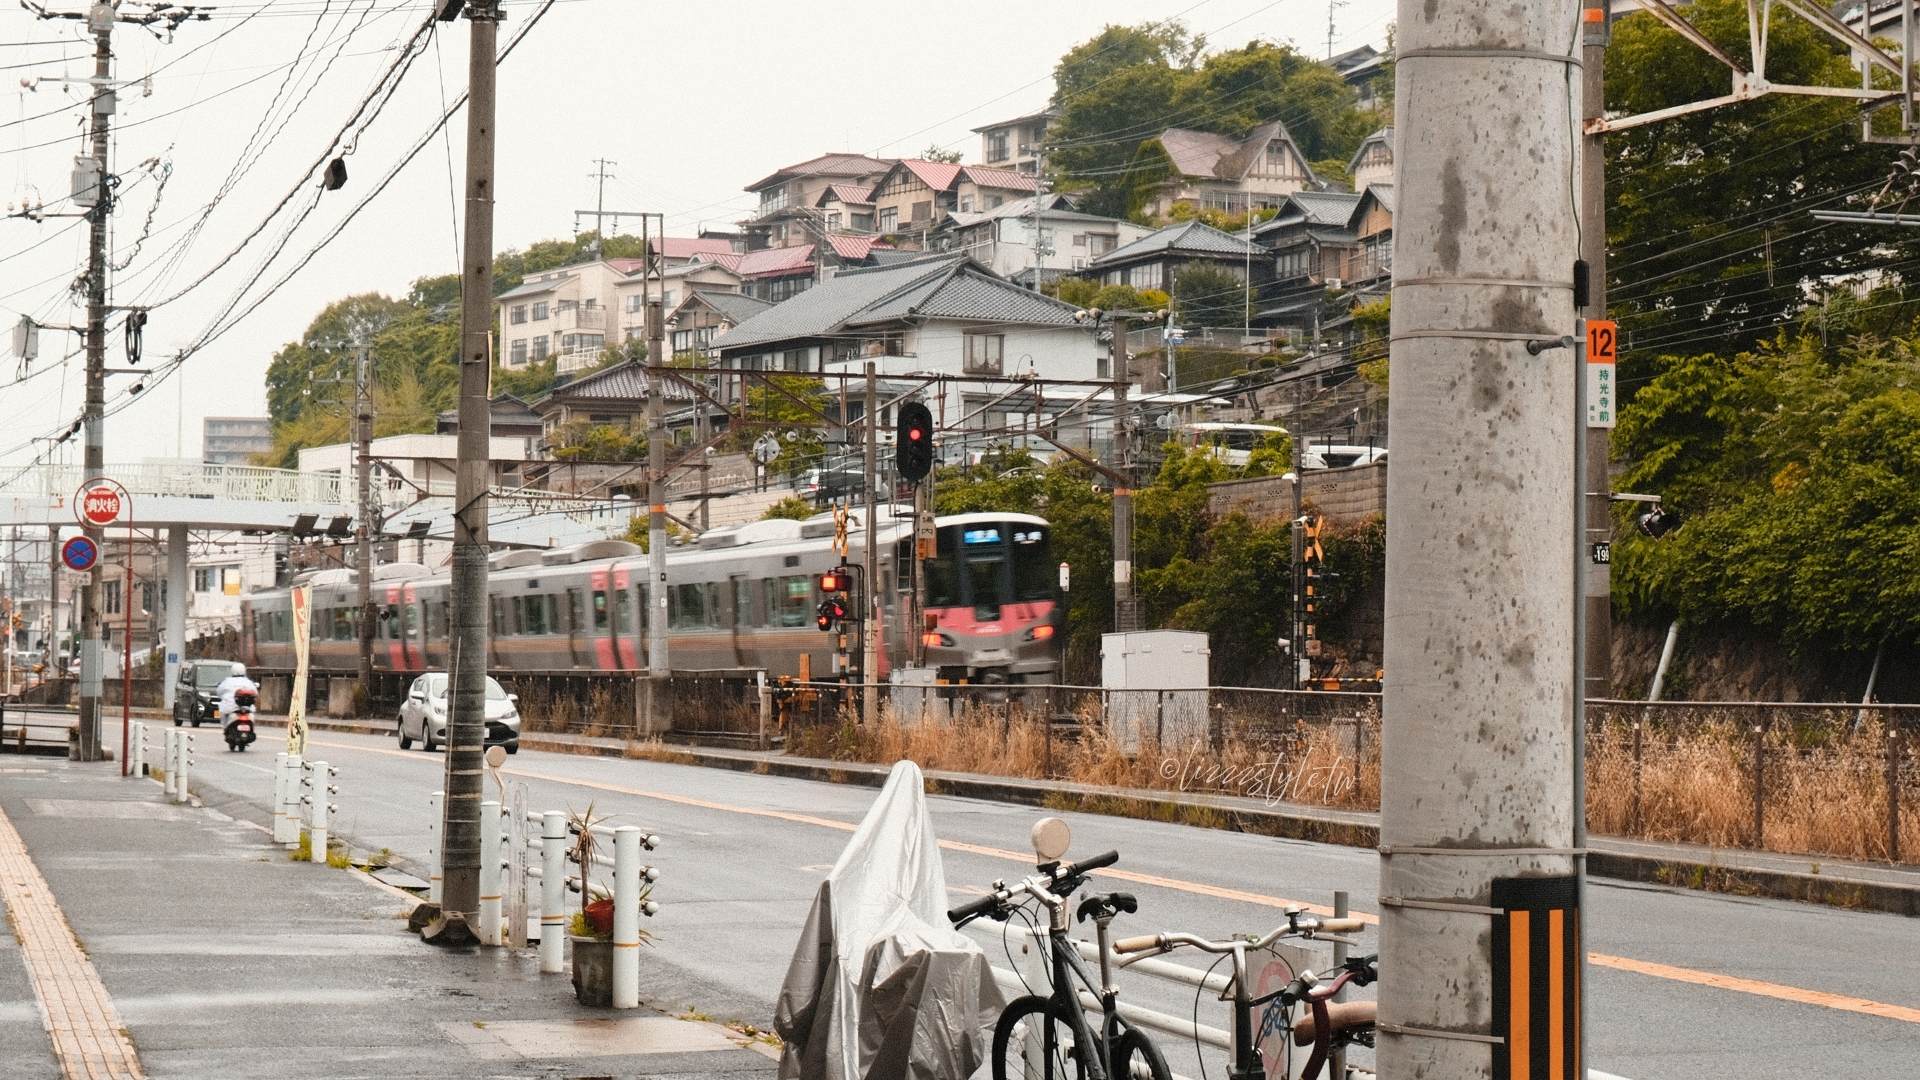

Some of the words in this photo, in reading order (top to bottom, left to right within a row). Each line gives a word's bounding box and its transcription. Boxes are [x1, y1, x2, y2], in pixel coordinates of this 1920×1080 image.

[1591, 328, 1612, 356] 12
[1599, 369, 1609, 422] 持光寺前
[86, 498, 118, 513] 消火栓
